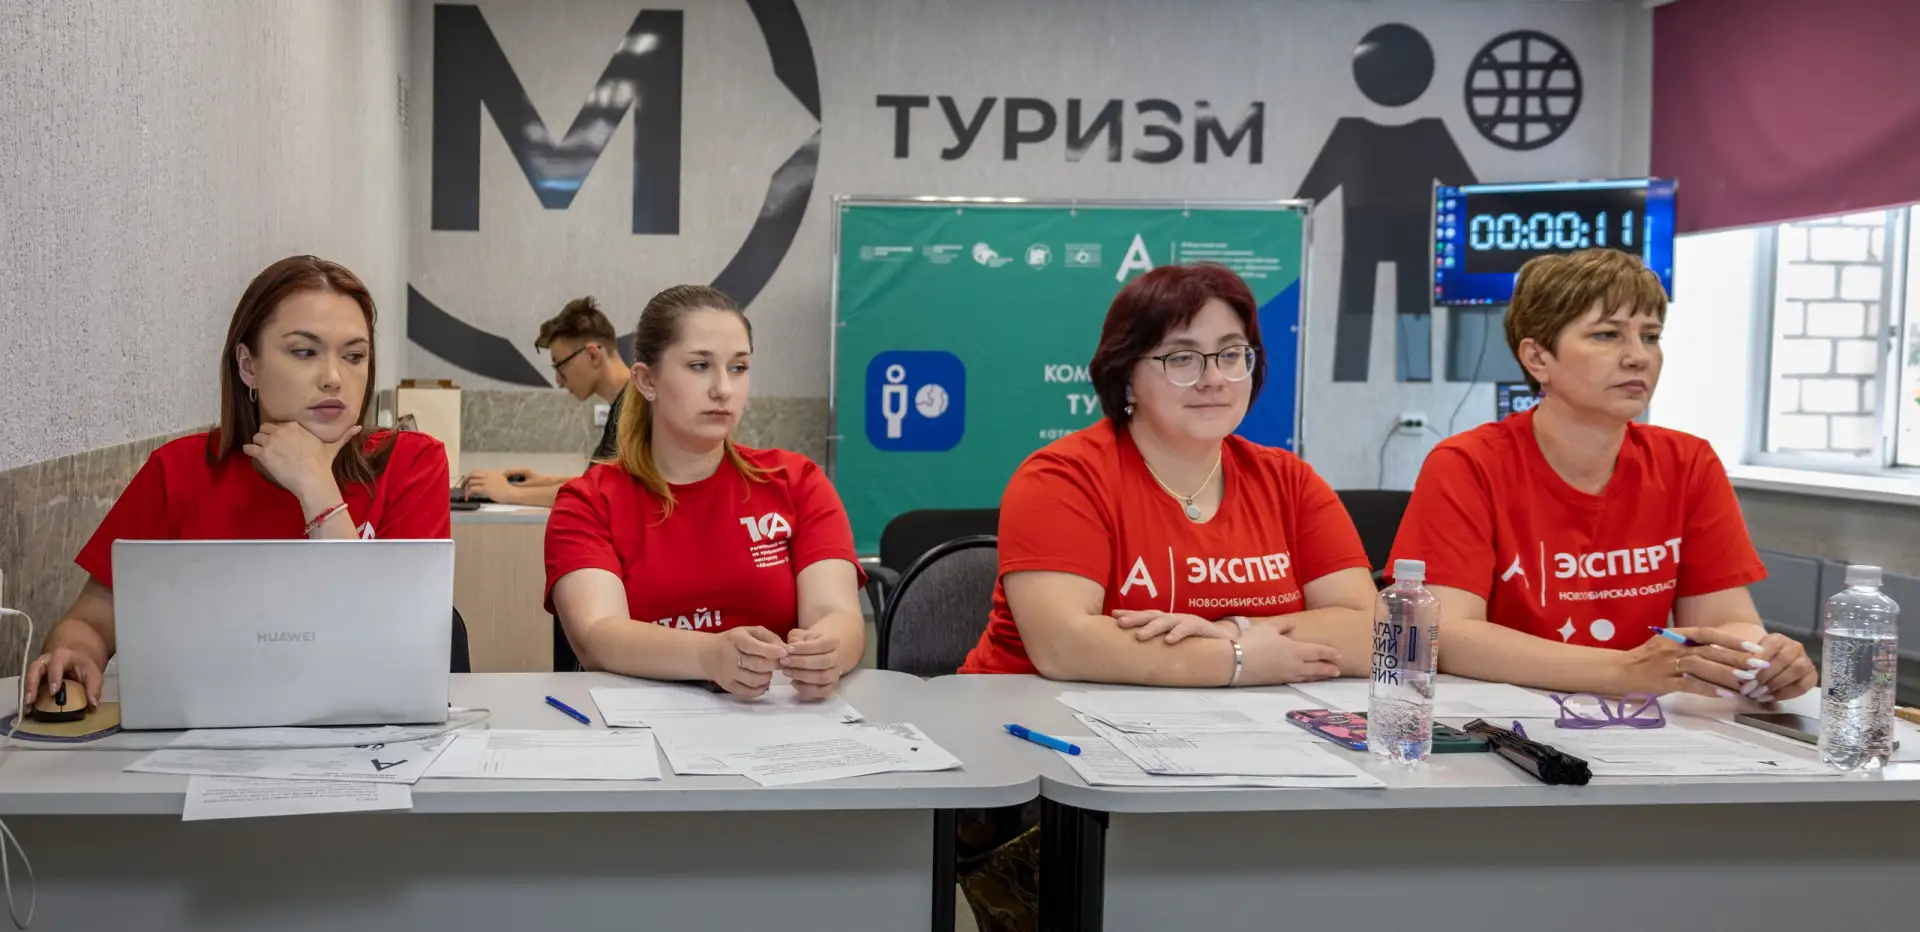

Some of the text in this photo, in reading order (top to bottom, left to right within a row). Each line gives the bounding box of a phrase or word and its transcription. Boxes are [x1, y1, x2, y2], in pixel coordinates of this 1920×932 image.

[876, 94, 1265, 165] ТУРИЗМ
[1469, 209, 1634, 250] 00:00:11
[1186, 550, 1290, 584] ЭКСПЕР
[1188, 595, 1277, 608] НОВОСИБИРСКАЯ
[651, 607, 722, 630] ТАЙ!
[256, 630, 316, 642] HUAWEI
